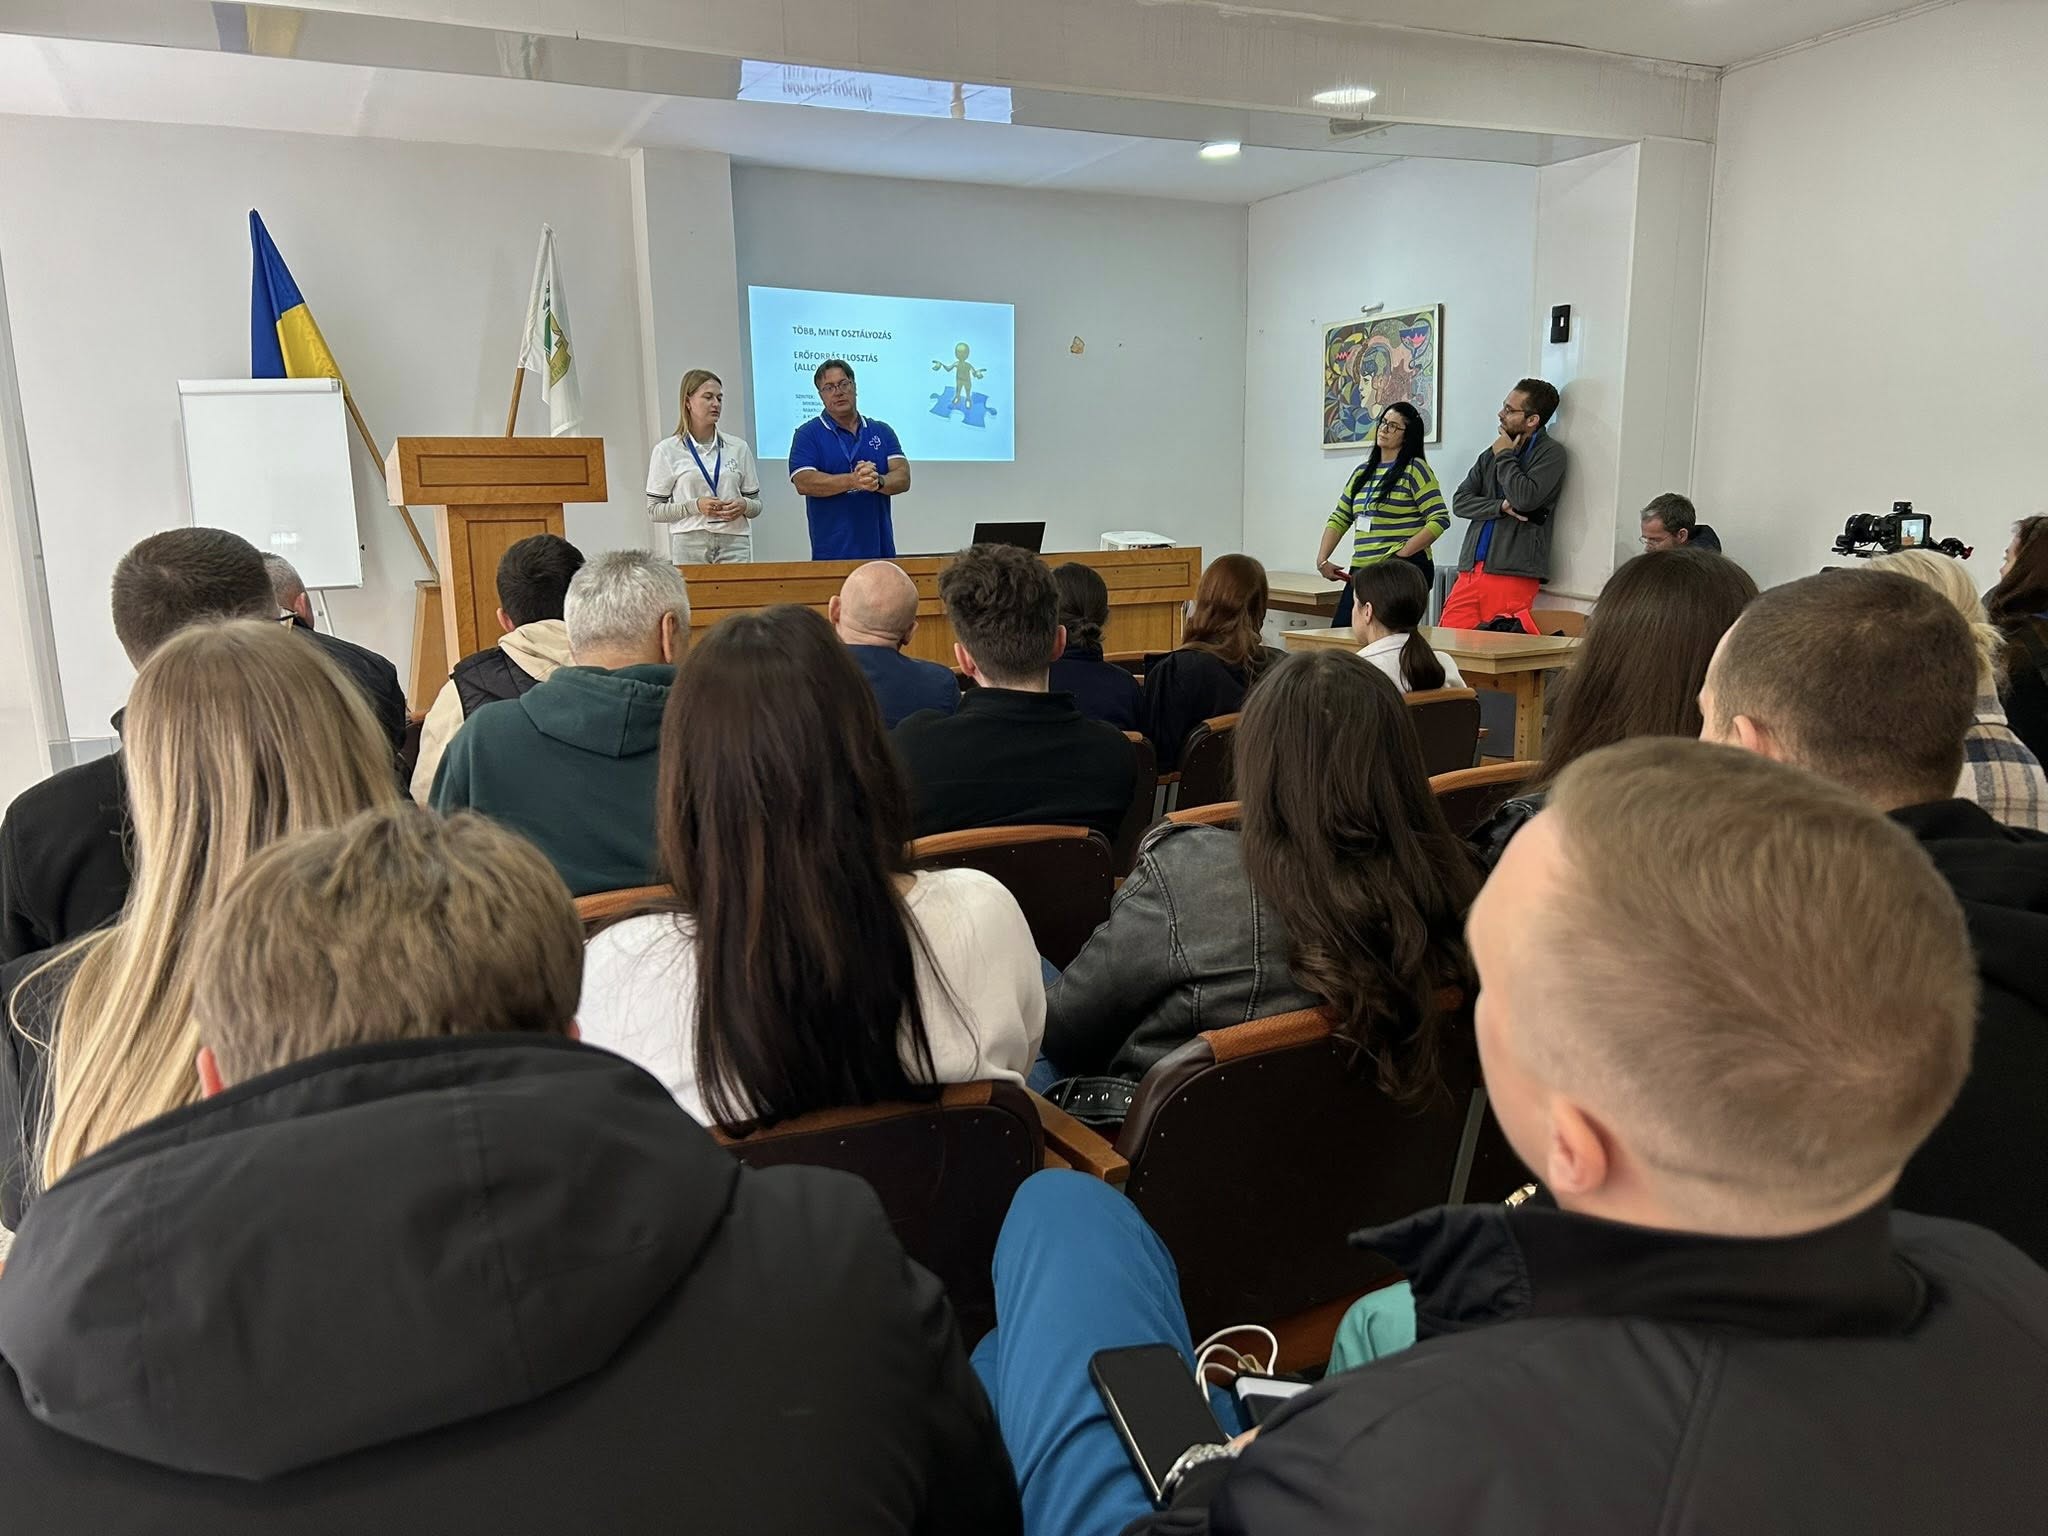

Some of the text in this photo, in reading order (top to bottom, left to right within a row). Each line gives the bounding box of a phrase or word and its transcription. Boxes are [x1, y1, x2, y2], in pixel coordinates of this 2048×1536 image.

[792, 325, 892, 340] TÖBB, MINT OSZTÁLYOZÁS
